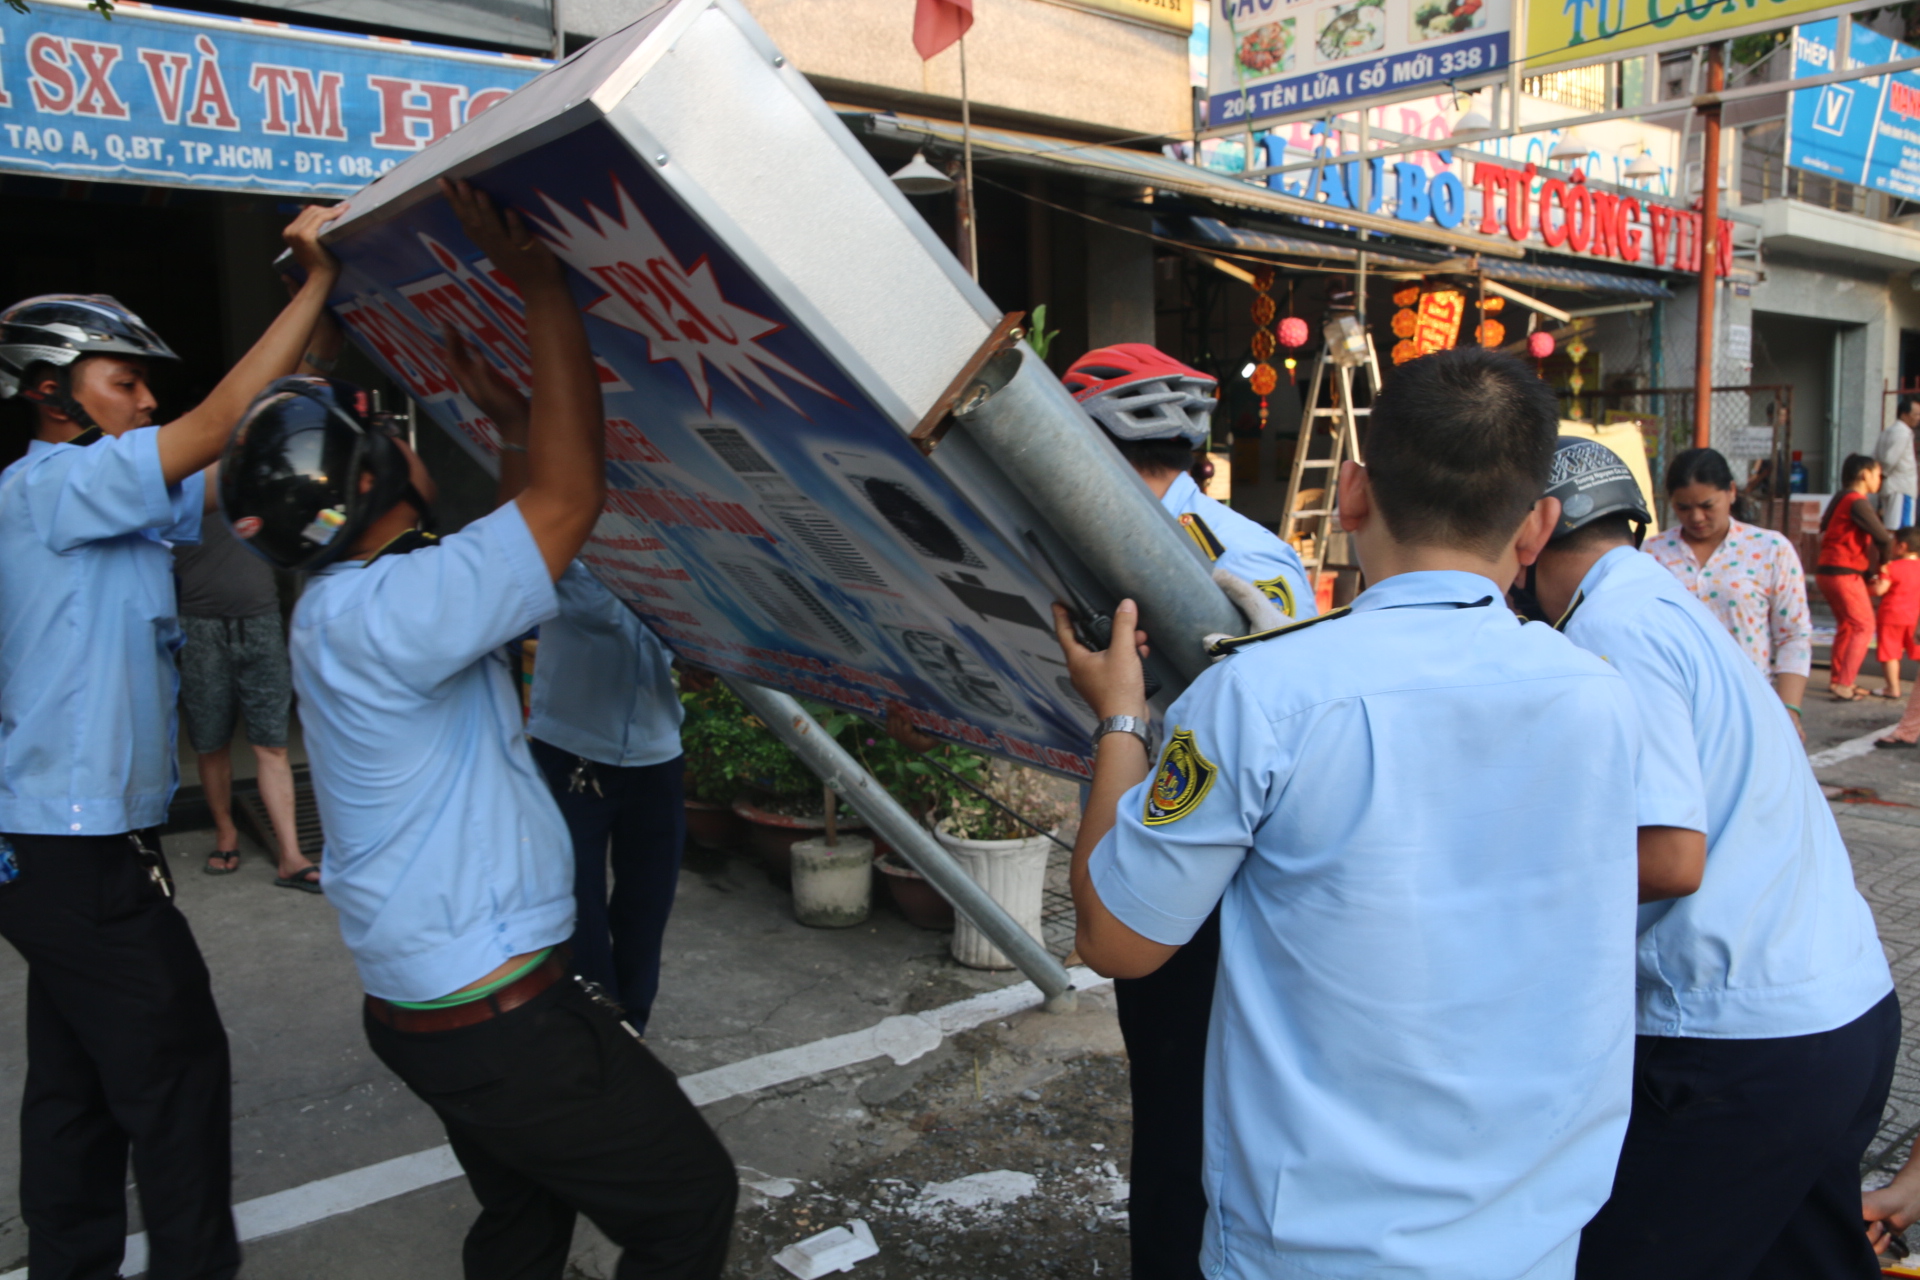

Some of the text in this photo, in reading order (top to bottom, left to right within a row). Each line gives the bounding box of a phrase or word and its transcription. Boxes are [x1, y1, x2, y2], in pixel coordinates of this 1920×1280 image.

[26, 31, 130, 121] SX
[137, 34, 240, 132] VÀ
[249, 63, 348, 142] TM
[1222, 95, 1256, 119] 204
[1260, 85, 1297, 110] TÊN
[1302, 76, 1340, 105] LỬA
[1359, 58, 1390, 90] SỐ
[1392, 56, 1433, 83] MỚI
[1439, 47, 1483, 75] 338
[1827, 90, 1845, 127] V
[4, 123, 63, 155] TẠO
[71, 131, 98, 160] A,
[180, 141, 273, 170] TP.HCM
[294, 151, 333, 175] ĐT:
[1394, 150, 1464, 229] BÒ
[1539, 168, 1642, 262] CÔNG
[588, 257, 740, 346] F2C
[1034, 743, 1092, 780] LONG
